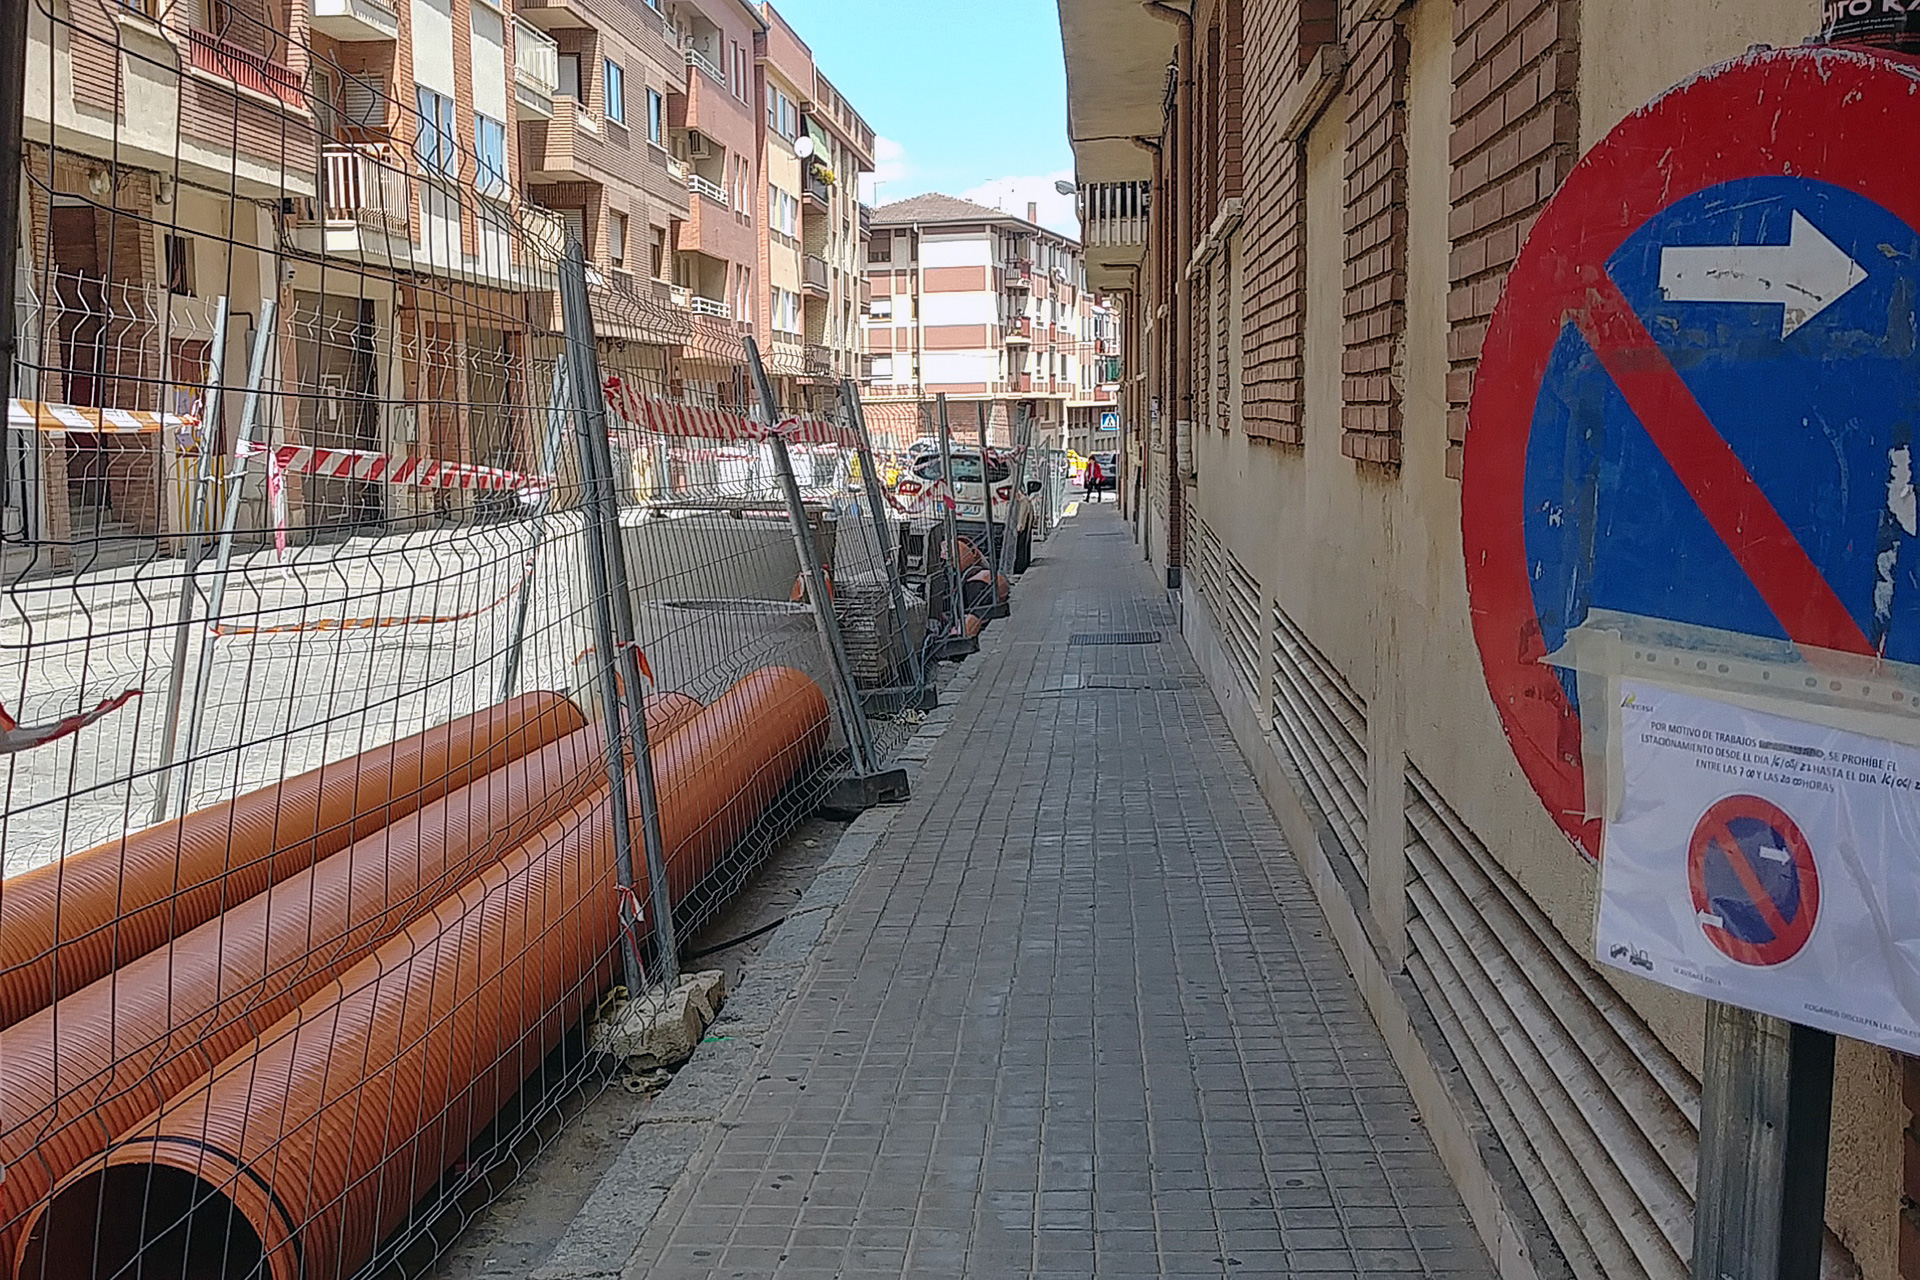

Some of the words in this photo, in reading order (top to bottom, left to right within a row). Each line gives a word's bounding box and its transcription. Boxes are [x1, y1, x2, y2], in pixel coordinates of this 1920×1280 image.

[1641, 733, 1714, 755] ESTACIONAMIENTO
[1715, 747, 1741, 760] DESDE
[1742, 751, 1752, 762] EL
[1813, 764, 1844, 779] HASTA
[1845, 769, 1856, 781] EL
[1651, 721, 1667, 732] POR
[1668, 724, 1701, 738] MOTIVO
[1702, 730, 1713, 740] DE
[1715, 732, 1757, 748] TRABAJOS
[1828, 751, 1840, 763] SE
[1841, 752, 1884, 769] PROHÍBE
[1886, 760, 1898, 772] EL
[1695, 759, 1721, 773] ENTRE
[1723, 763, 1738, 775] LAS
[1756, 771, 1762, 780] Y
[1764, 771, 1779, 784] LAS
[1802, 778, 1835, 793] HORAS
[1804, 1003, 1840, 1018] ROGAMOS
[1841, 1012, 1879, 1028] DISCULPEN
[1880, 1022, 1892, 1032] LAS
